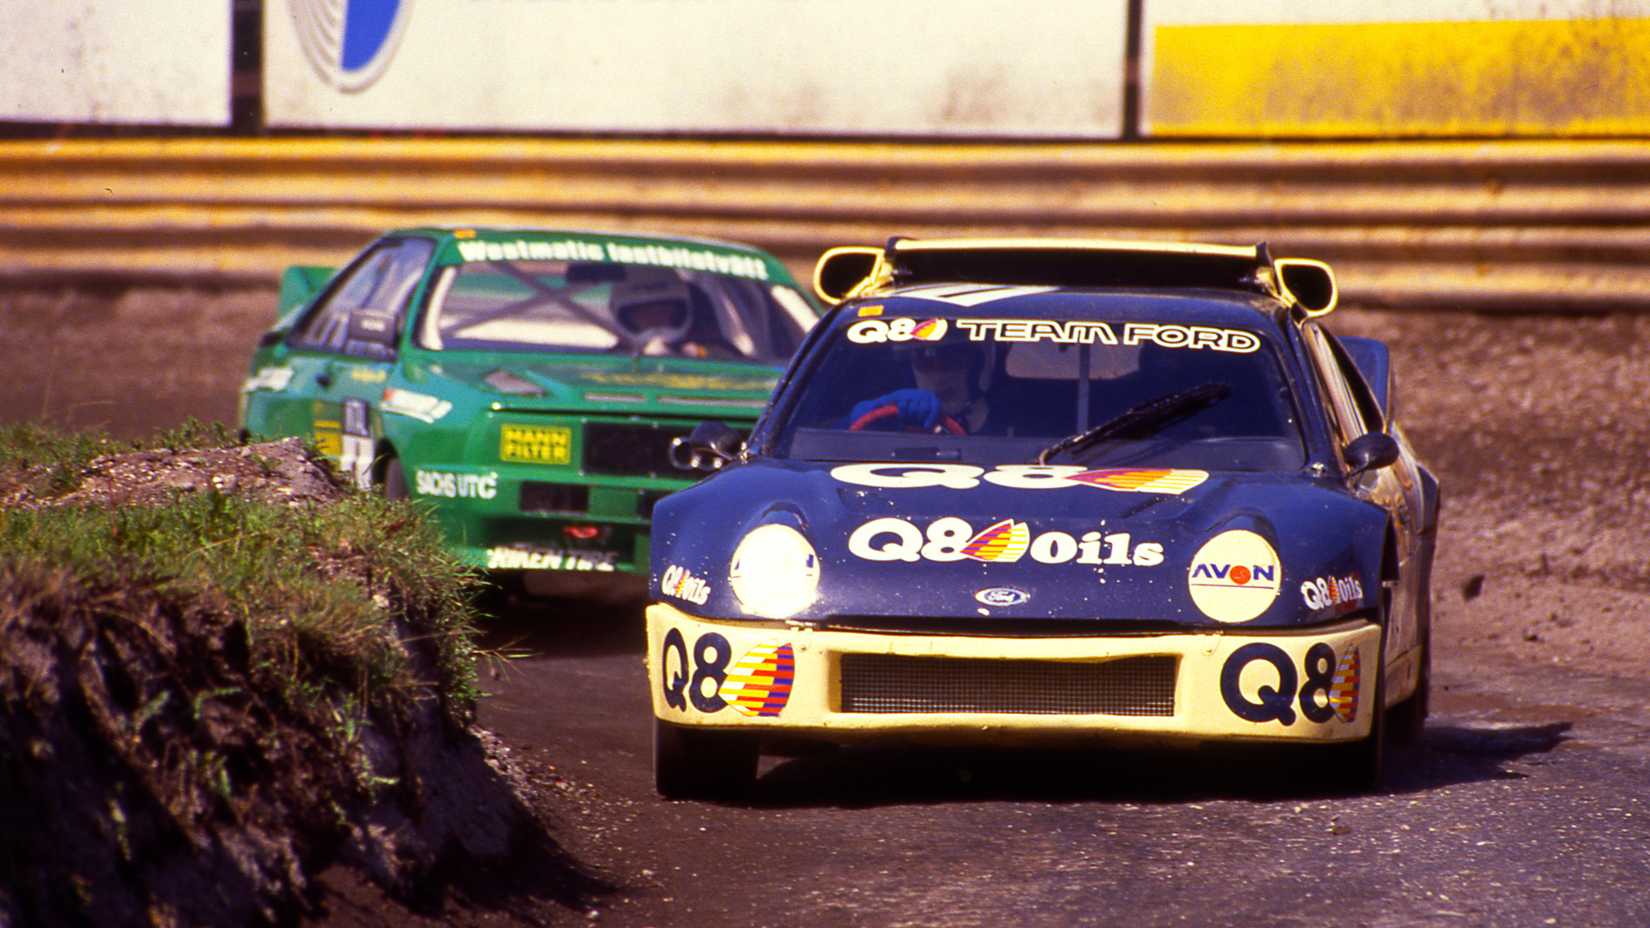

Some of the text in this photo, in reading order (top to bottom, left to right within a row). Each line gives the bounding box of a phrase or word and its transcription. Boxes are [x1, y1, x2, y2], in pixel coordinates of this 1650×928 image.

[847, 318, 1261, 353] Q8 TEAM FORD
[504, 429, 568, 446] MANN
[830, 463, 1088, 490] Q8
[848, 517, 973, 562] Q8
[1192, 564, 1274, 584] AVON
[1300, 577, 1332, 610] Q8
[663, 627, 732, 713] Q8
[1220, 642, 1337, 726] Q8
